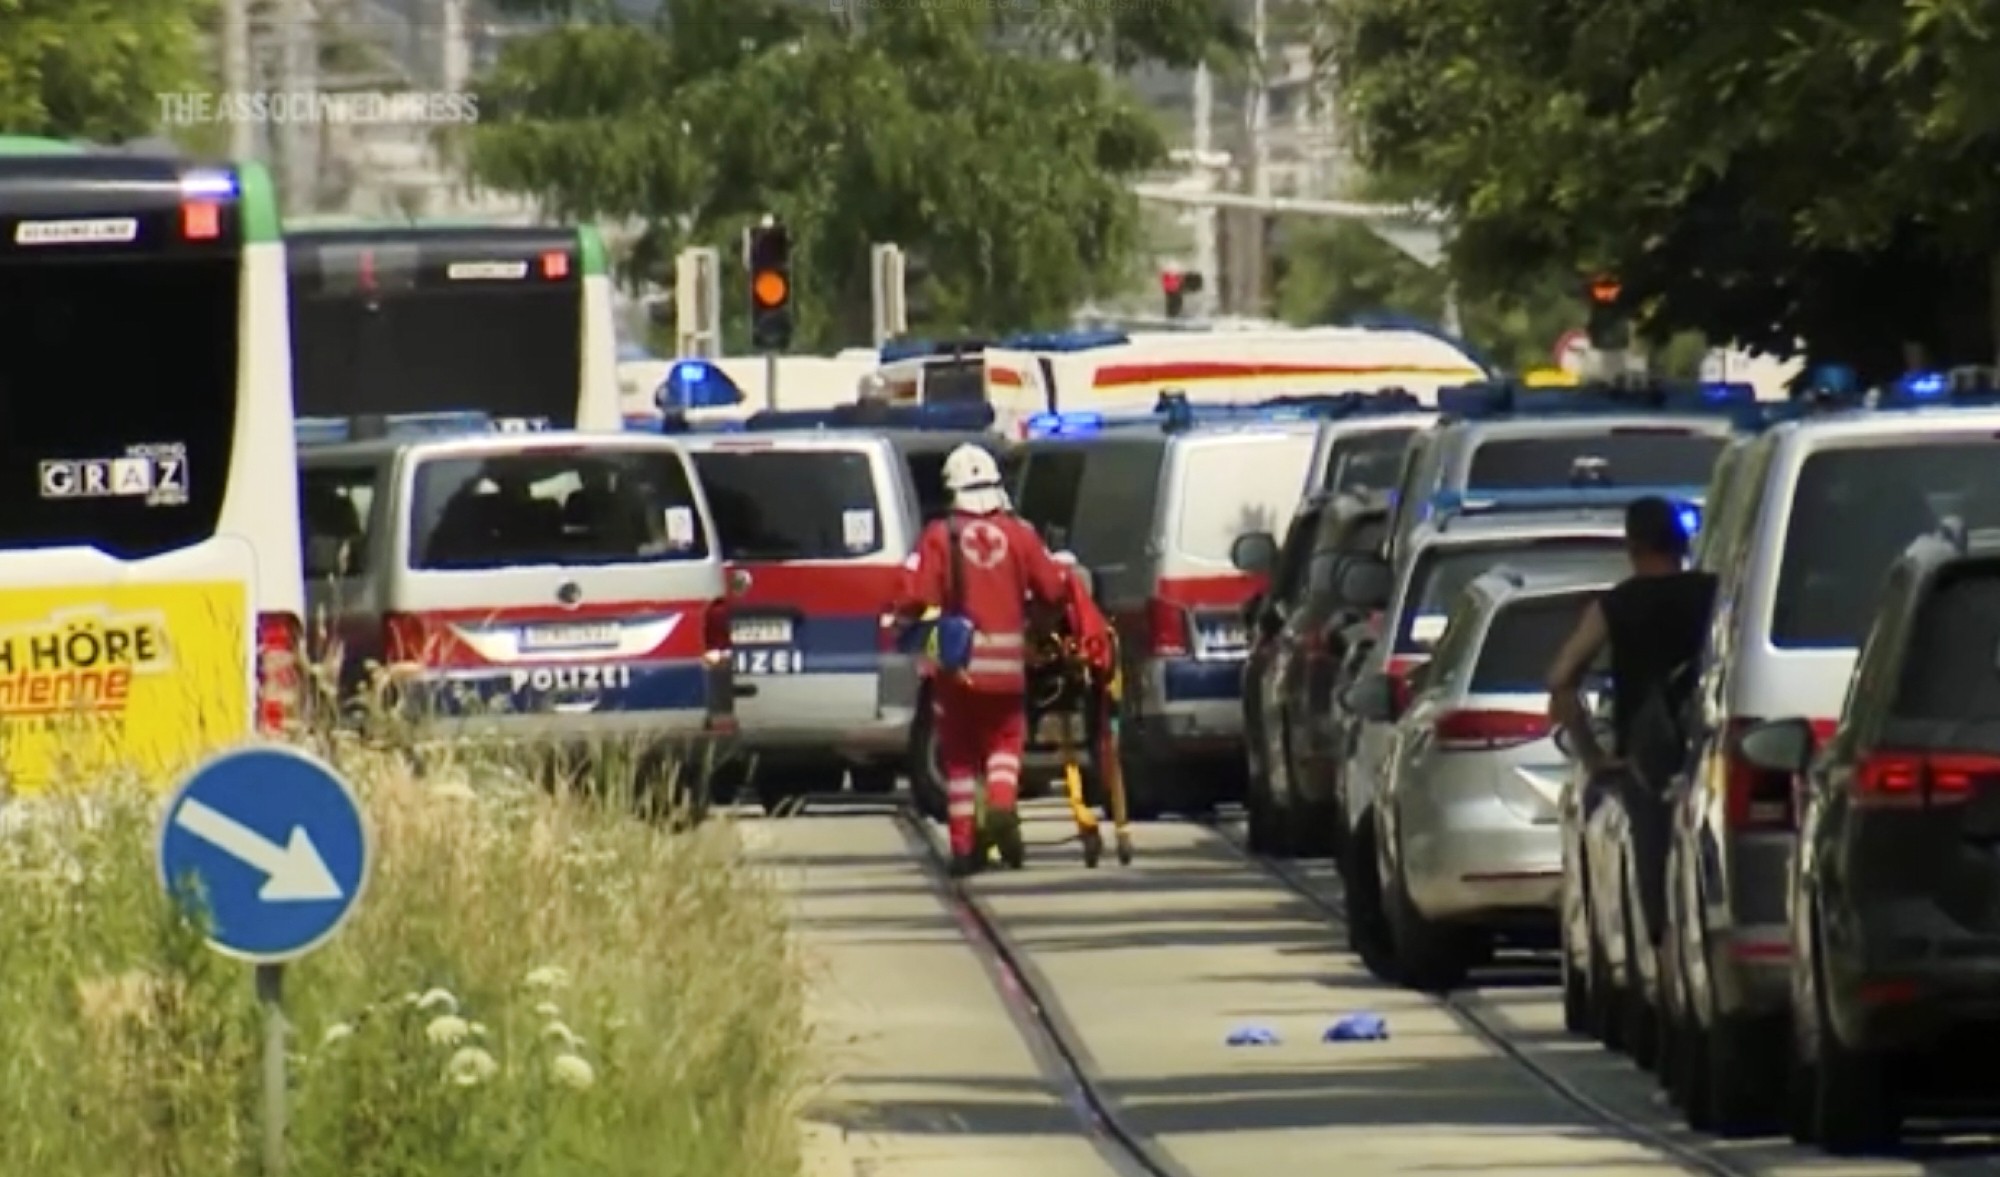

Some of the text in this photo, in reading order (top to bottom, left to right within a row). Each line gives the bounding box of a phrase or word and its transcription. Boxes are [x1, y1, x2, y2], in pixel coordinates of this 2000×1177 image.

[42, 459, 186, 496] GRAZ
[31, 621, 156, 669] HÖRE
[734, 650, 803, 673] IZEI
[509, 665, 631, 694] POLIZEI
